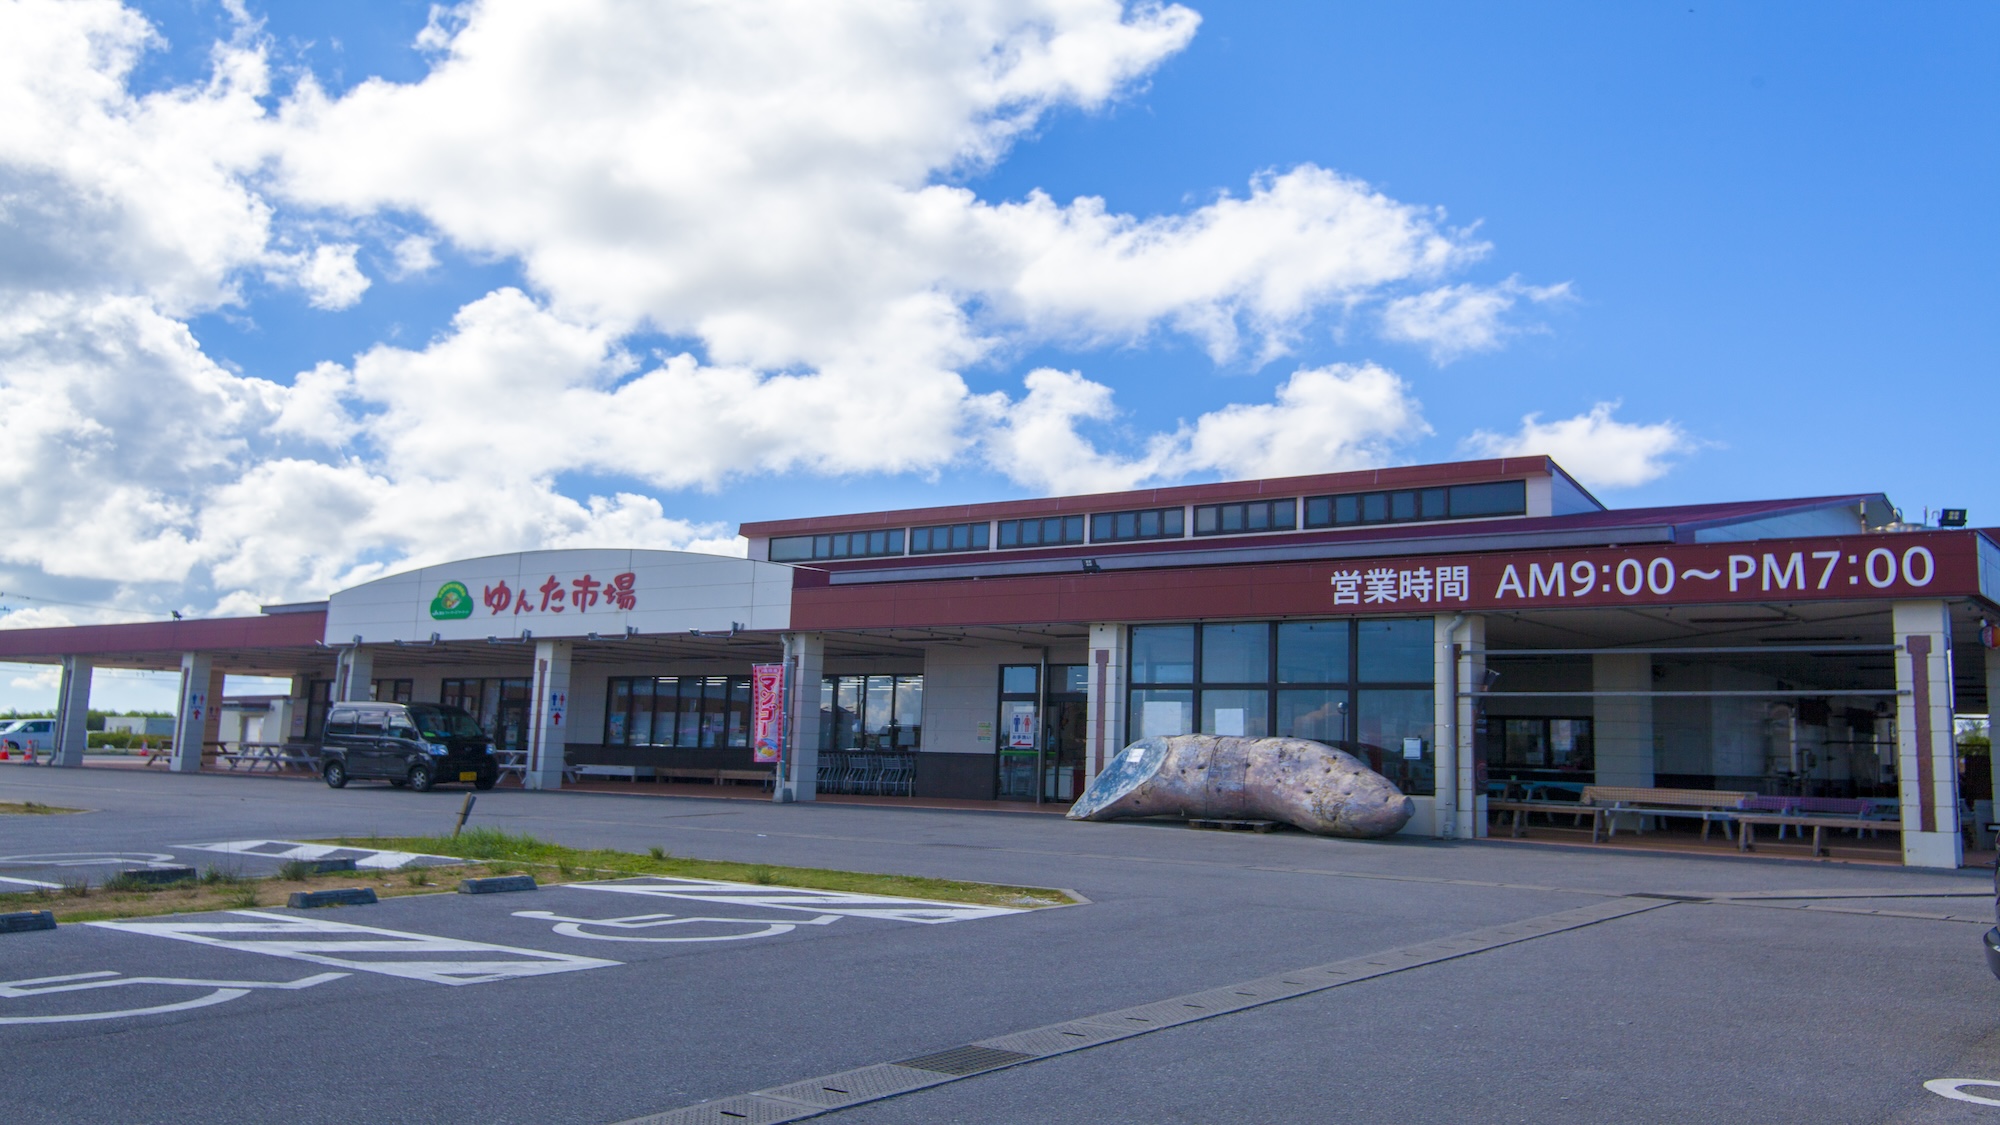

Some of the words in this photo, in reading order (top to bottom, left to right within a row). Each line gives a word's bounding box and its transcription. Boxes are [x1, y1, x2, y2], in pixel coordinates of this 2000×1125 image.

[484, 572, 636, 616] ゆんた市場
[1331, 566, 1469, 605] 営業時間
[760, 676, 778, 737] マンゴー
